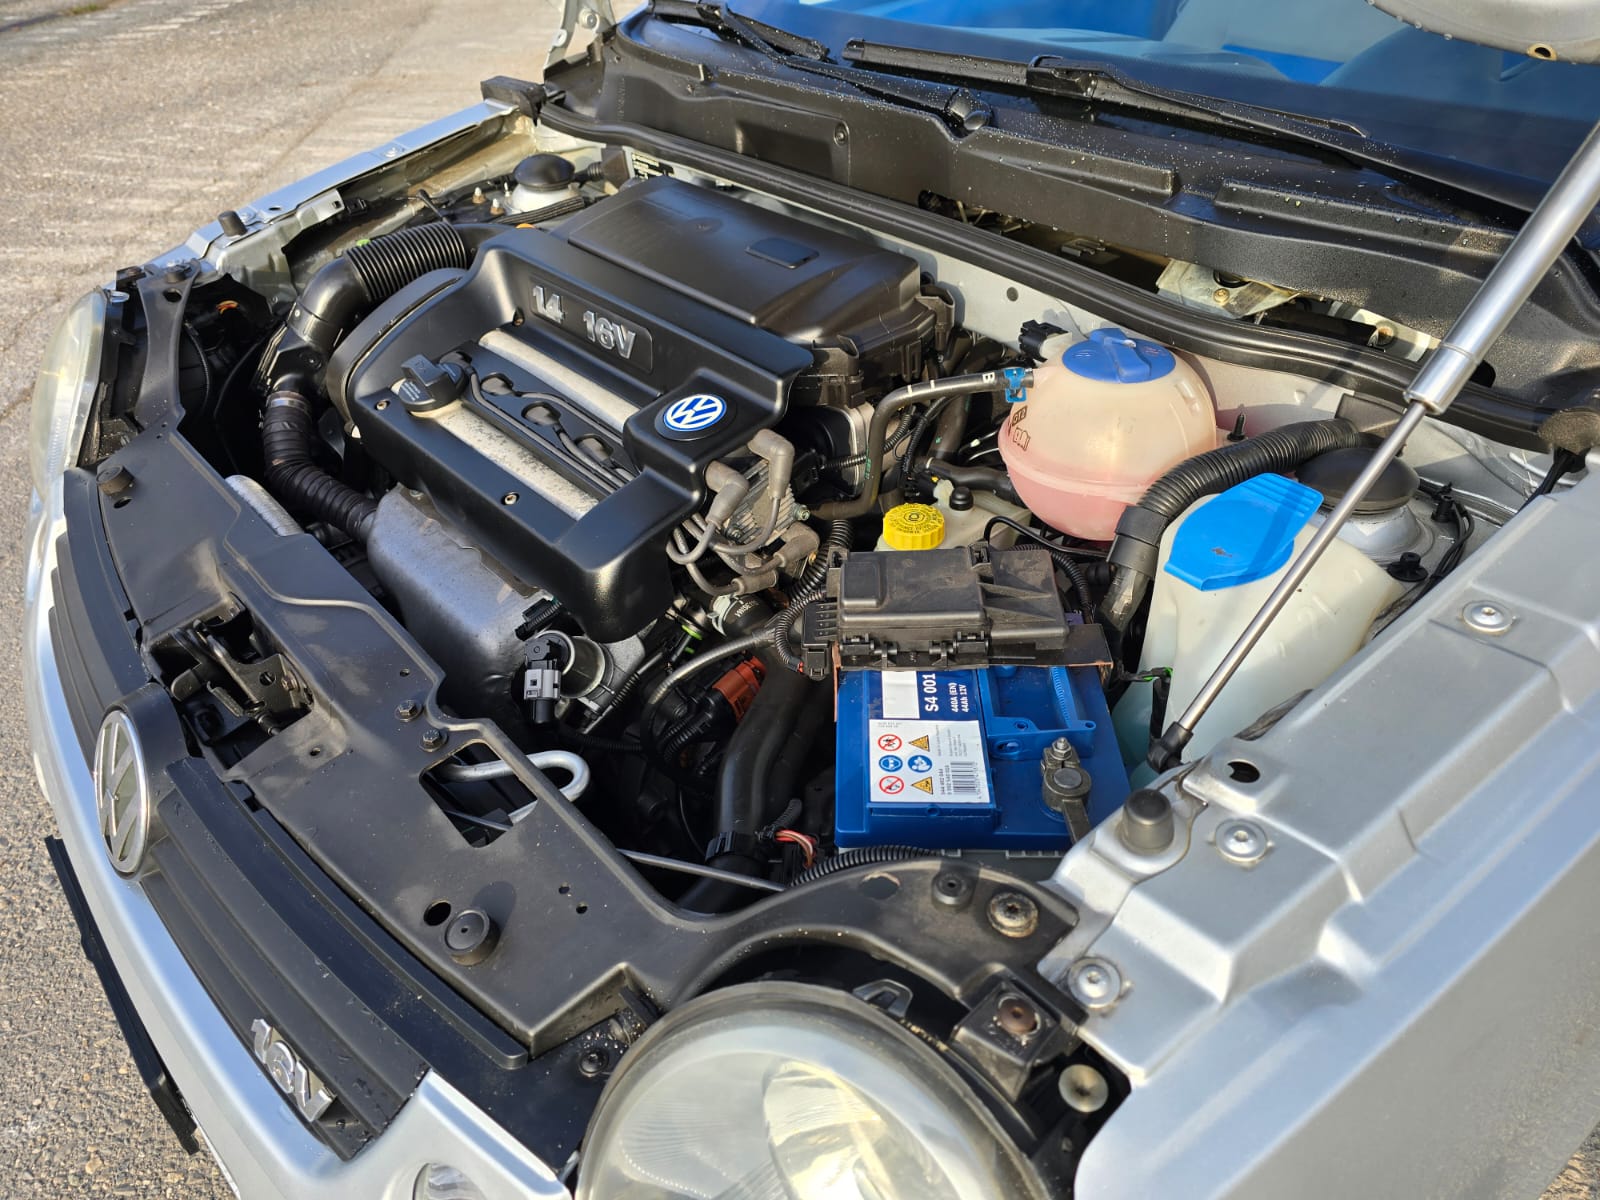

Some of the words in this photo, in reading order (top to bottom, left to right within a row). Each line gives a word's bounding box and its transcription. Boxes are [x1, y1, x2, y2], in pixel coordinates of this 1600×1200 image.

[583, 311, 635, 358] 16V
[664, 395, 726, 431] VW
[922, 673, 937, 694] 001
[948, 682, 958, 695] (EN)
[959, 684, 967, 695] 12V
[924, 696, 939, 712] S4
[950, 696, 959, 712] 440A
[960, 696, 969, 712] 44Ah
[251, 1019, 334, 1122] 16V
